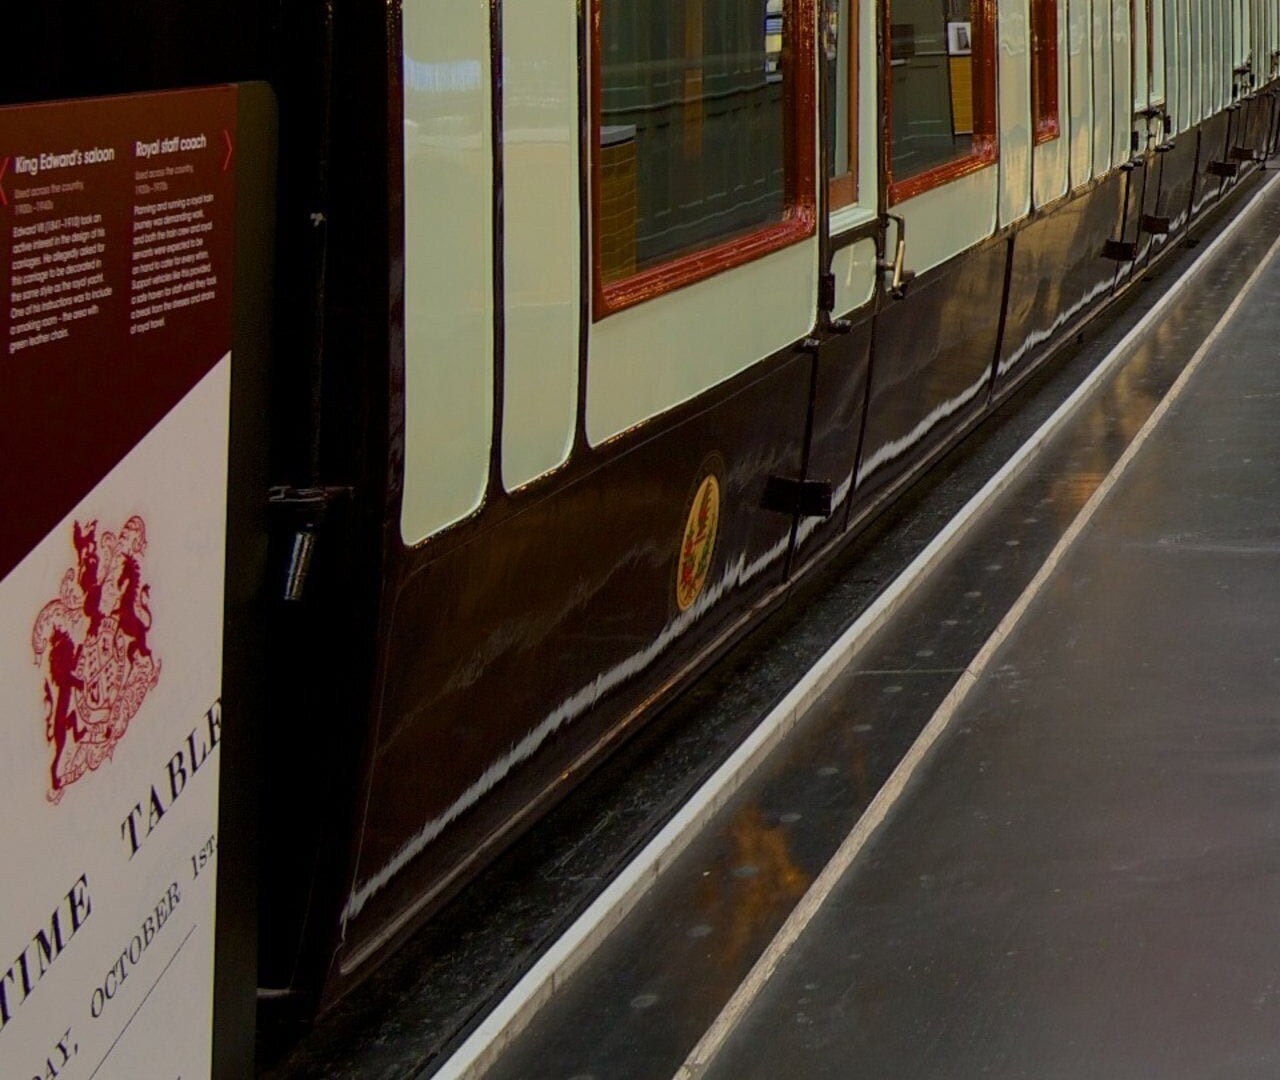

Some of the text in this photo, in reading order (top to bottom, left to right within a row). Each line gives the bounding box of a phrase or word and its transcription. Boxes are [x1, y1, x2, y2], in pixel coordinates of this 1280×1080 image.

[15, 147, 115, 176] King Edward's saloon
[135, 133, 207, 159] Royal staff coach
[0, 696, 222, 1032] TIME TABLE
[90, 881, 182, 1019] OCTOBER
